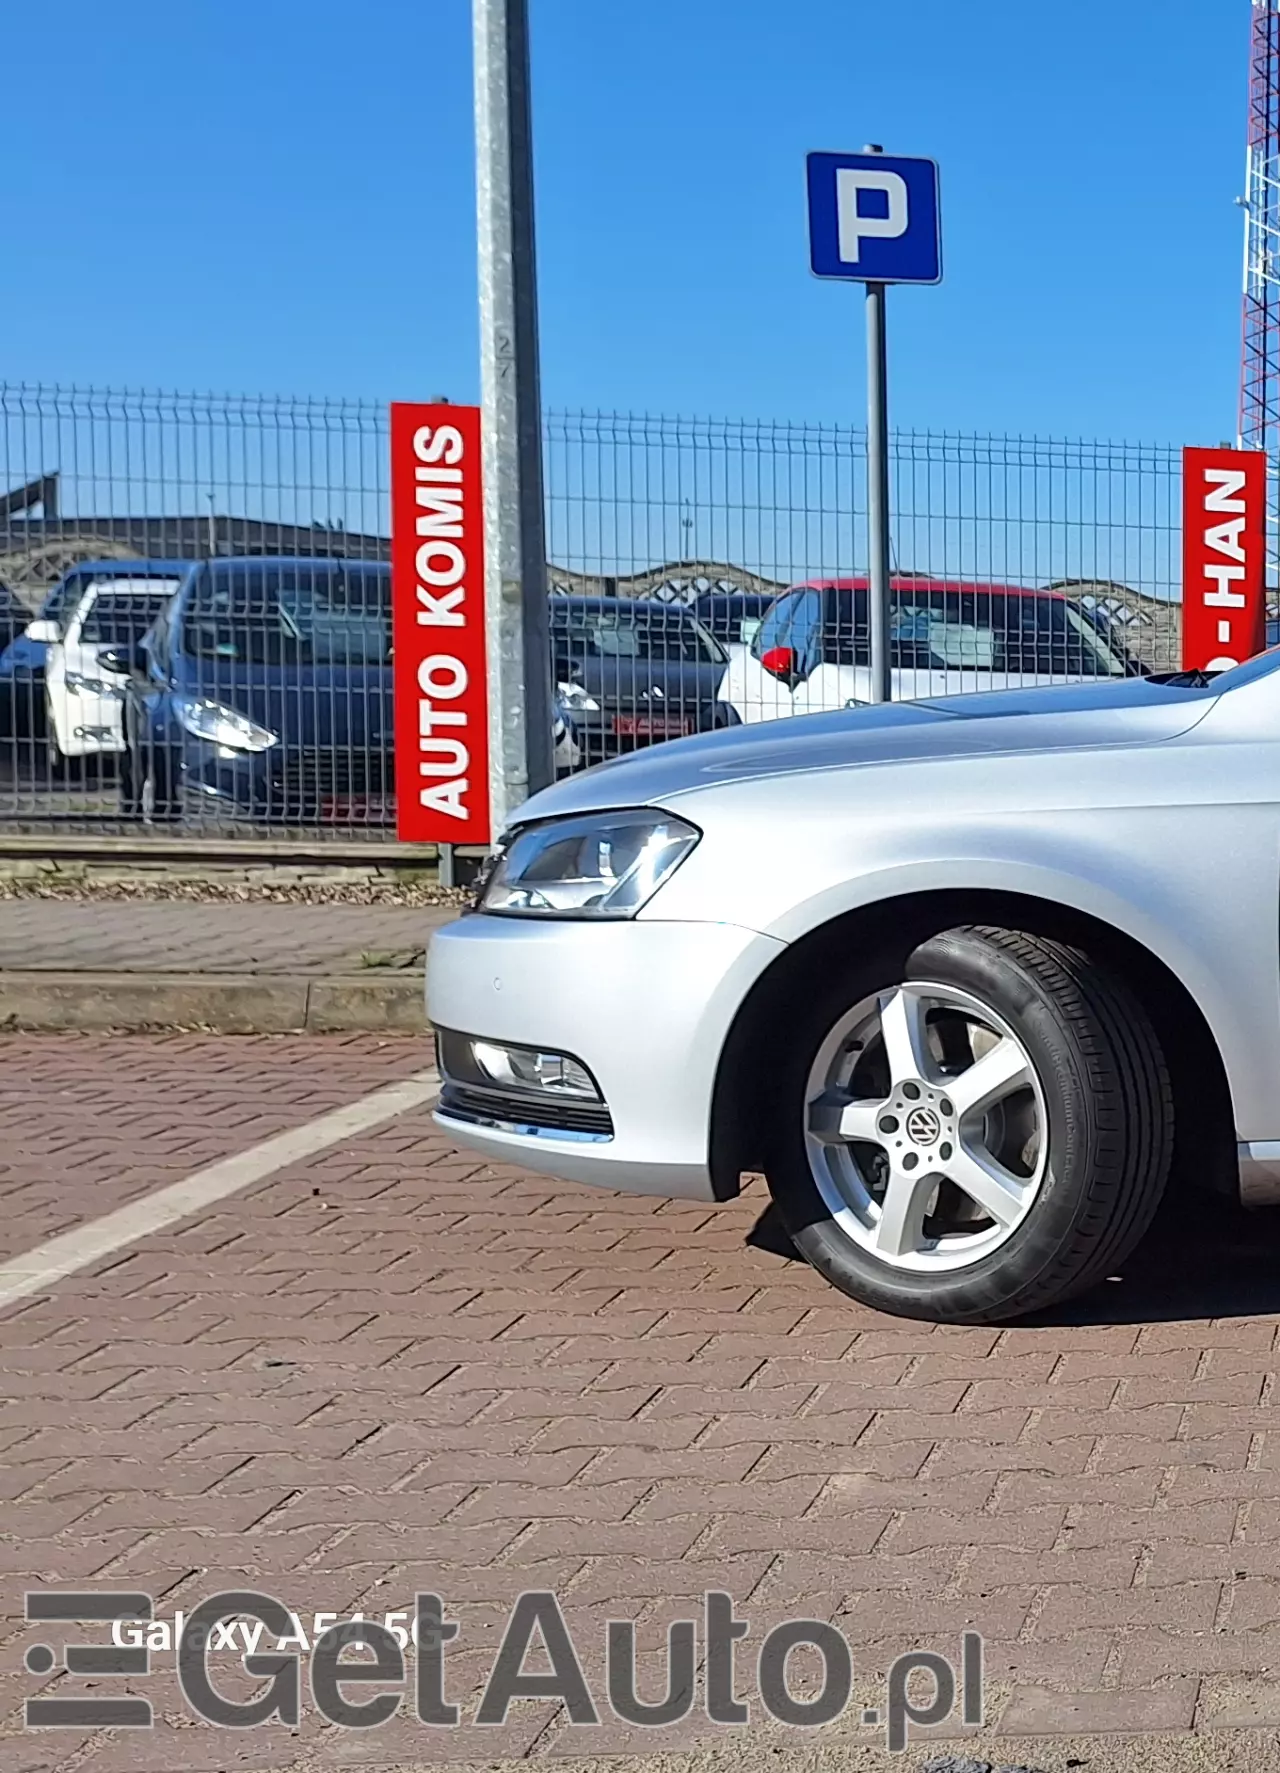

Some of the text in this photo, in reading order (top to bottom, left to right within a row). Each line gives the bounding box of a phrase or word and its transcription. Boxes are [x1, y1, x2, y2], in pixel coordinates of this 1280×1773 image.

[836, 168, 908, 263] P
[1203, 469, 1246, 609] HAN
[413, 424, 470, 821] AUTO KOMIS
